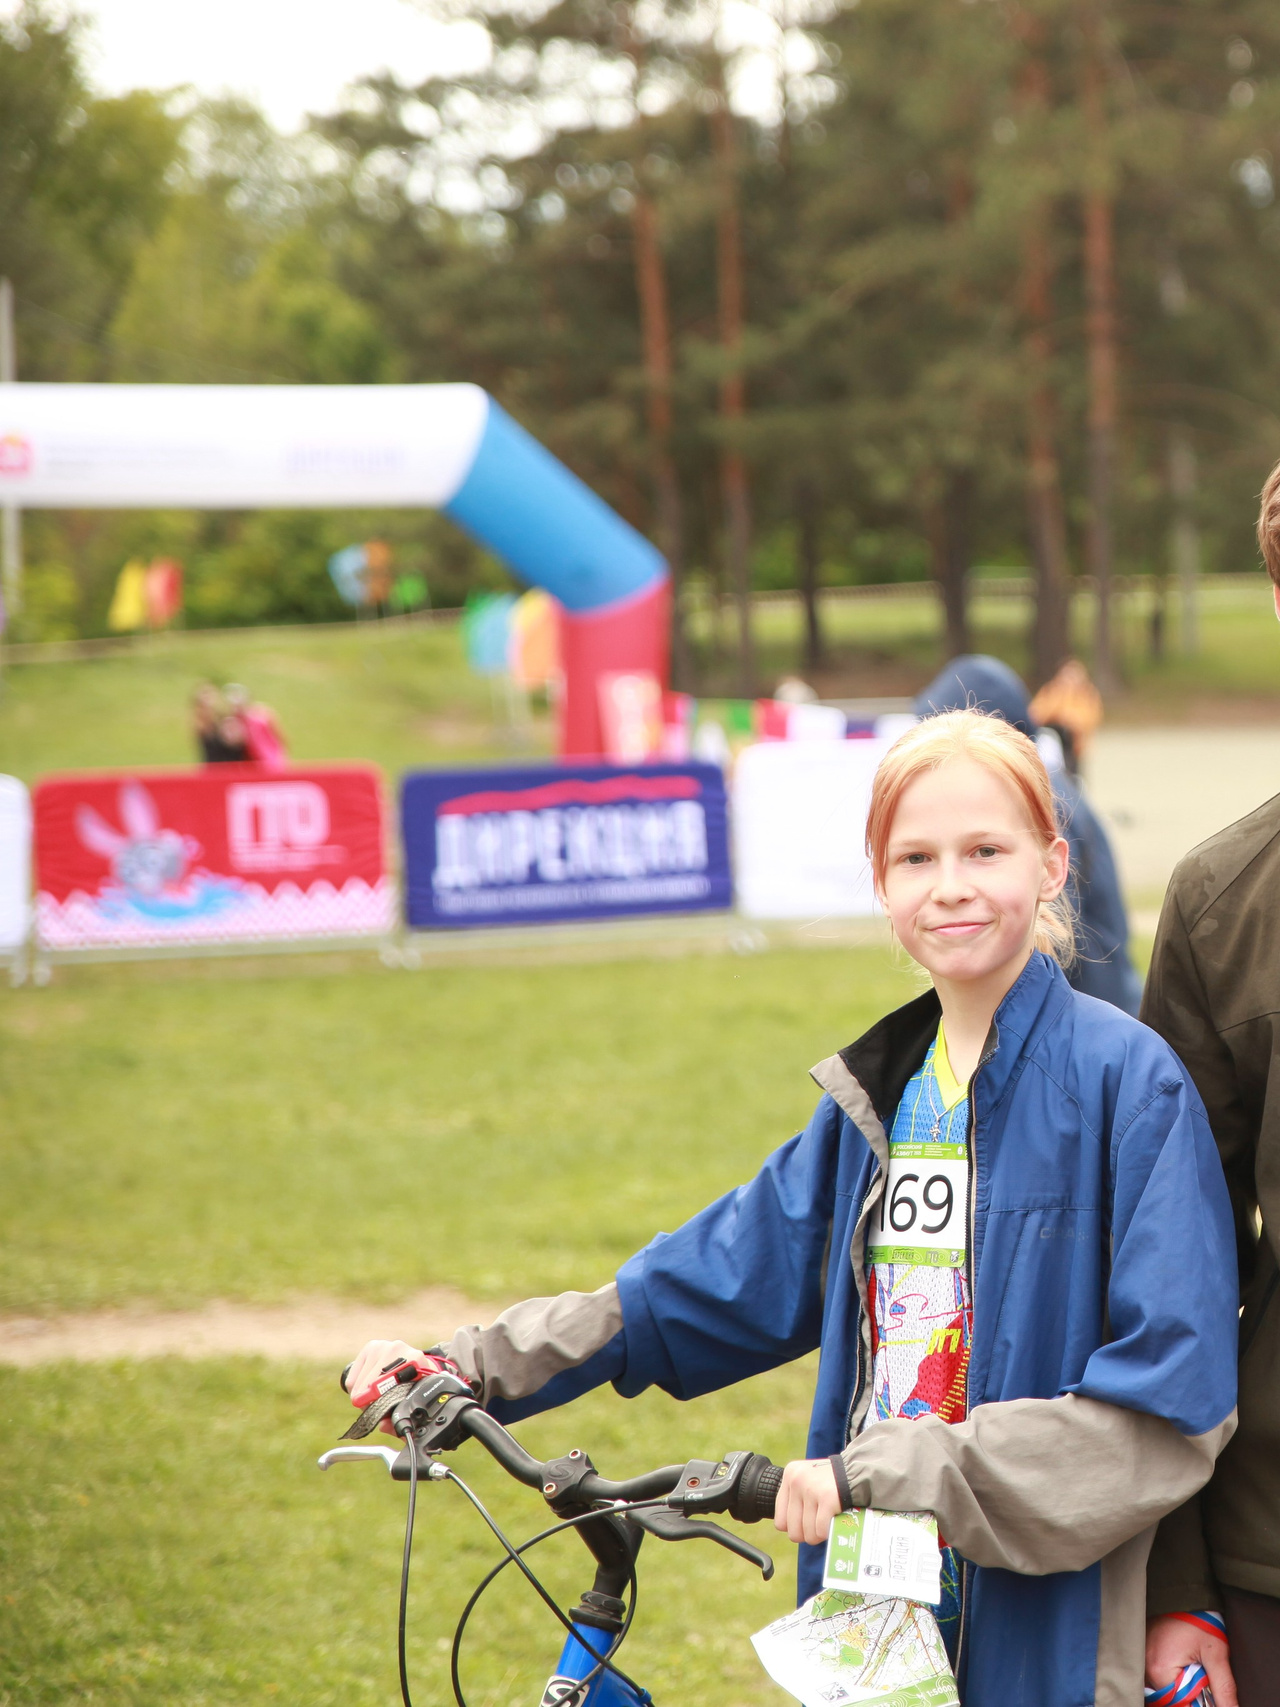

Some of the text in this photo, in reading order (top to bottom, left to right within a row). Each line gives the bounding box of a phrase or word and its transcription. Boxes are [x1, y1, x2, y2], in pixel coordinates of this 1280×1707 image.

[432, 801, 708, 888] ДИРЕКЦИЯ
[893, 1536, 909, 1581] ДИРЕКЦИЯ
[926, 1685, 953, 1697] 1:5000
